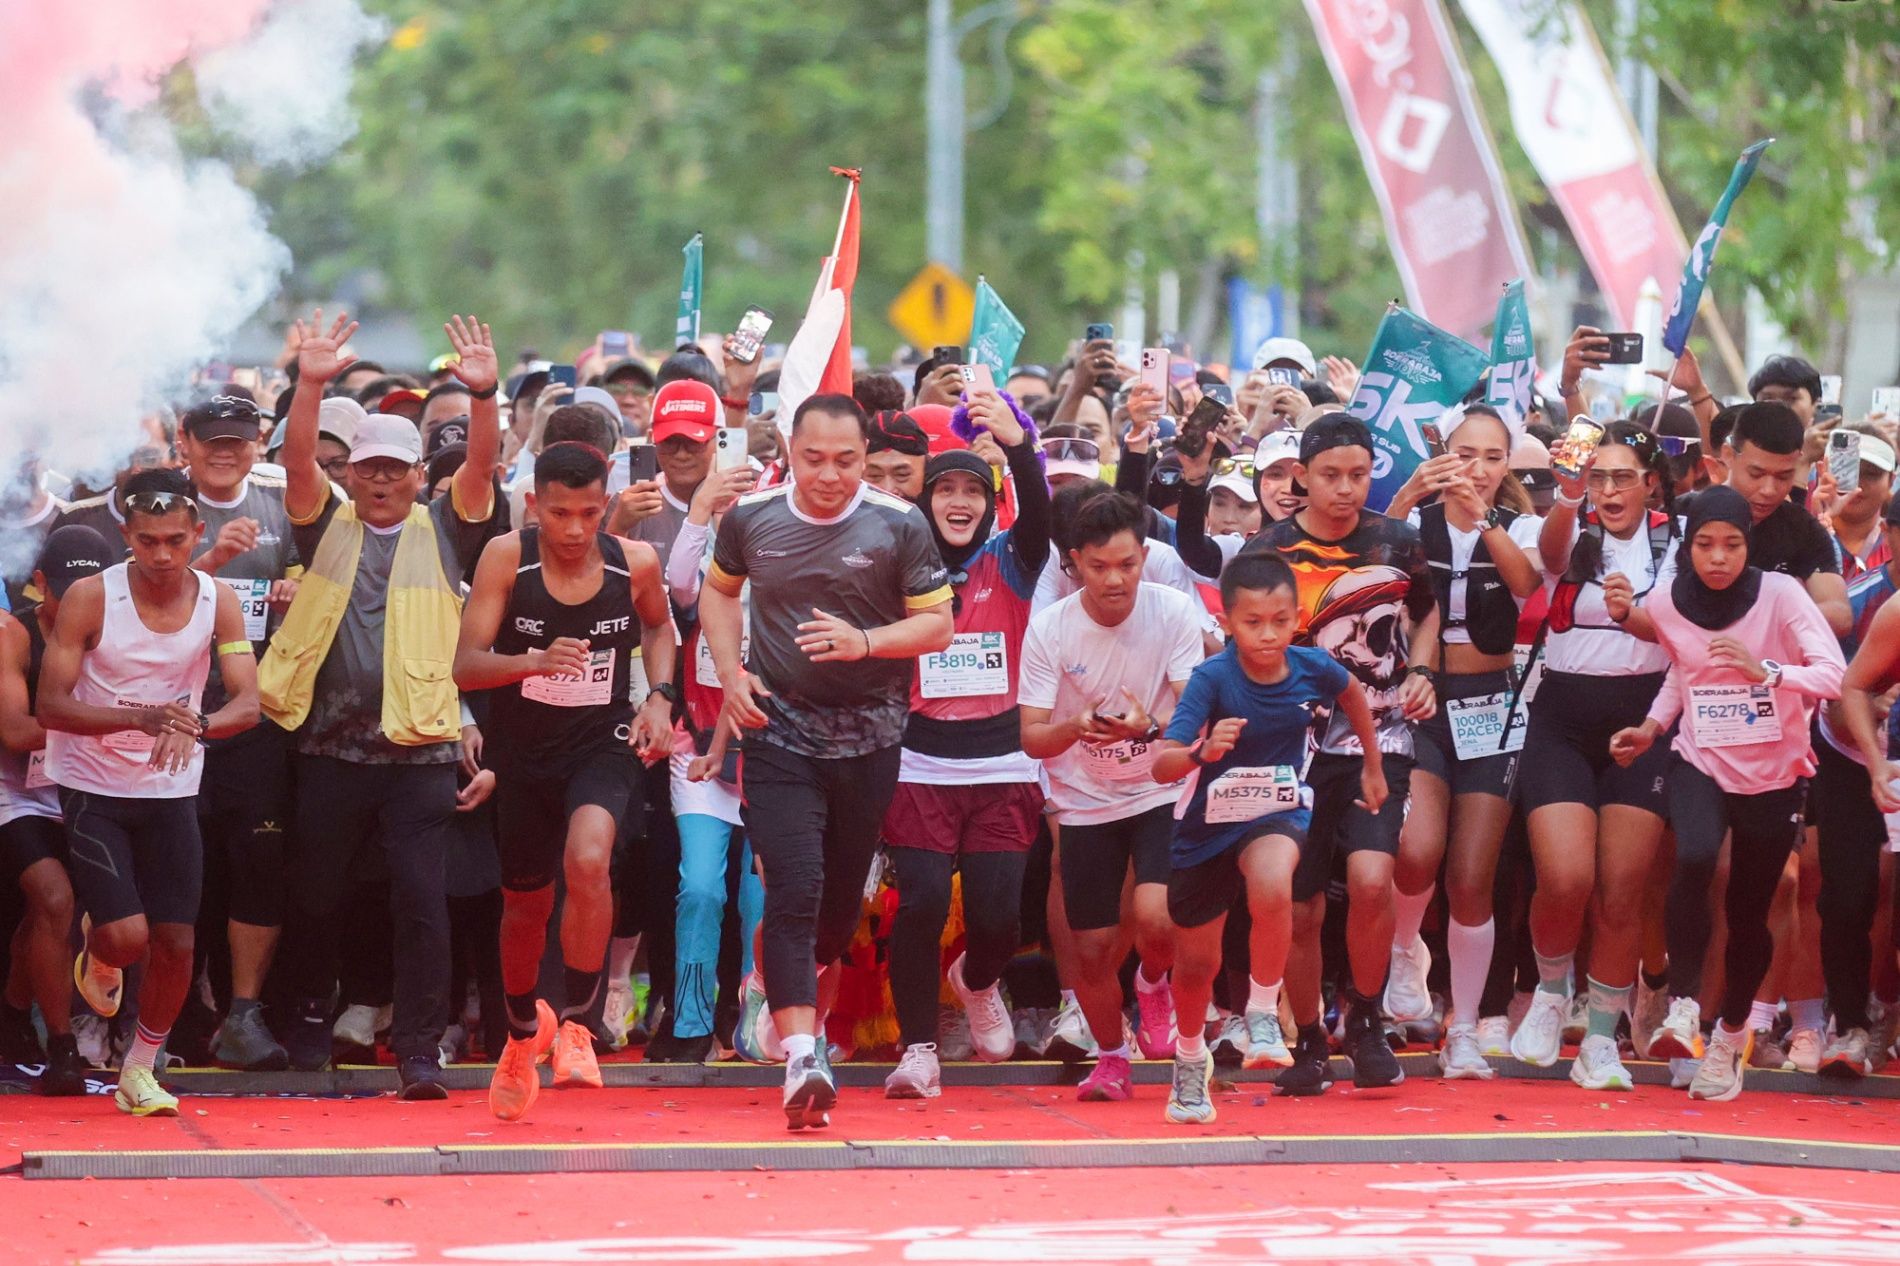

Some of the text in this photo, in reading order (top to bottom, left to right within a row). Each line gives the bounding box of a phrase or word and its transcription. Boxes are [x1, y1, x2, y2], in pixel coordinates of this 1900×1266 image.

[1490, 357, 1536, 415] 5K
[1350, 371, 1449, 460] 5K
[66, 560, 101, 568] LYCAN
[515, 616, 545, 633] CRC
[589, 616, 630, 635] JETE
[928, 653, 978, 670] F5819
[1454, 712, 1498, 727] 100018
[1697, 703, 1750, 719] F6278
[1457, 722, 1504, 739] PACER
[1219, 767, 1273, 779] OERABAJA
[1213, 787, 1272, 800] M5375
